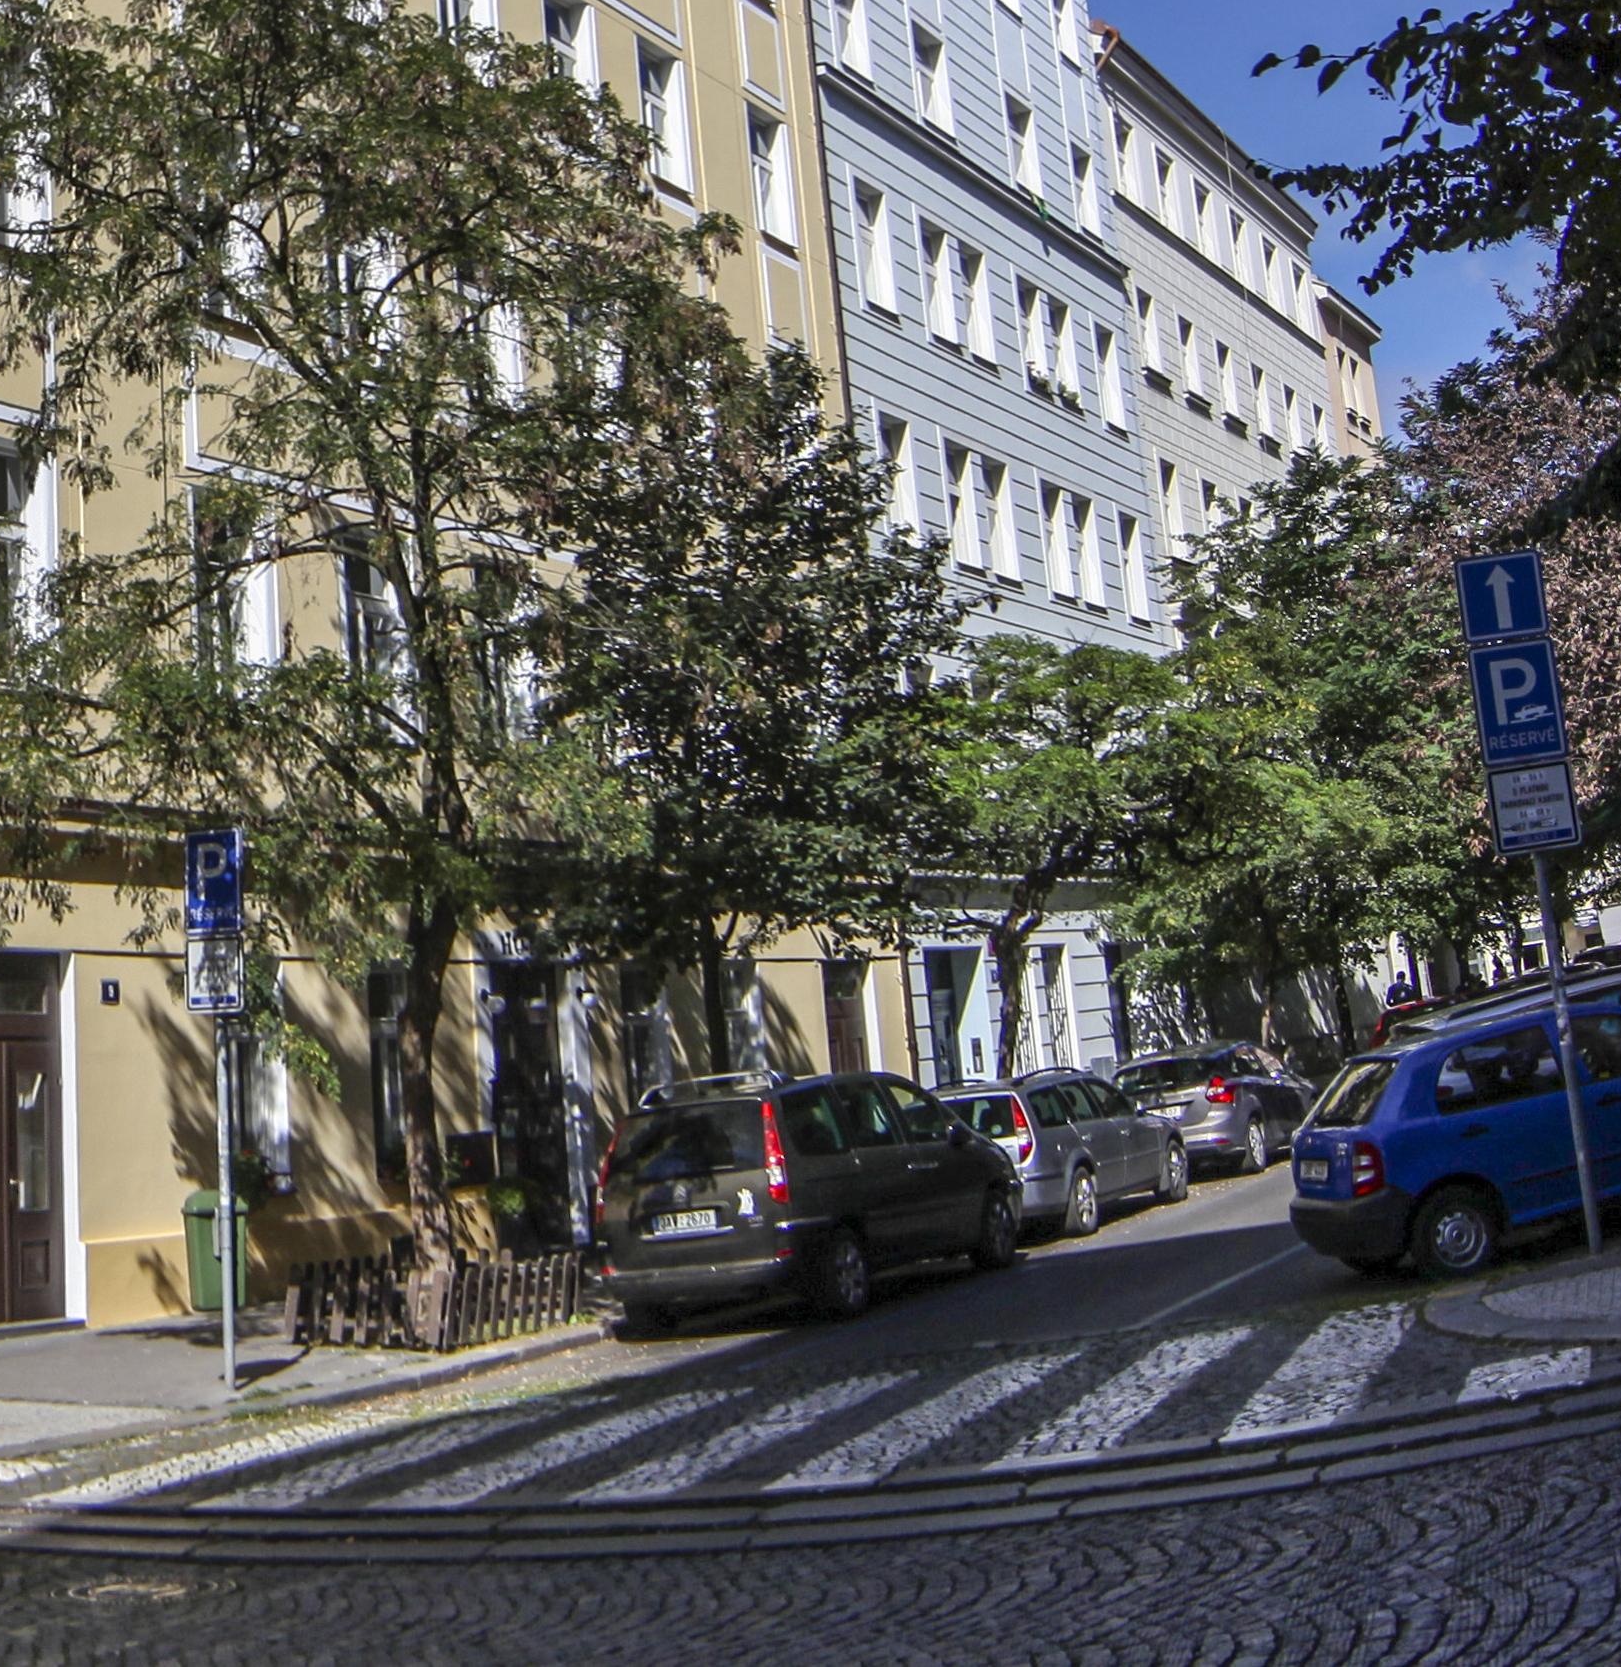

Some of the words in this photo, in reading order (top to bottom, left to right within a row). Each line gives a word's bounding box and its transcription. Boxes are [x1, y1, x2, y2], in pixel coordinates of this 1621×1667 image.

[1489, 658, 1537, 726] P
[1489, 724, 1556, 750] RÉSERVÉ
[197, 843, 227, 901] P
